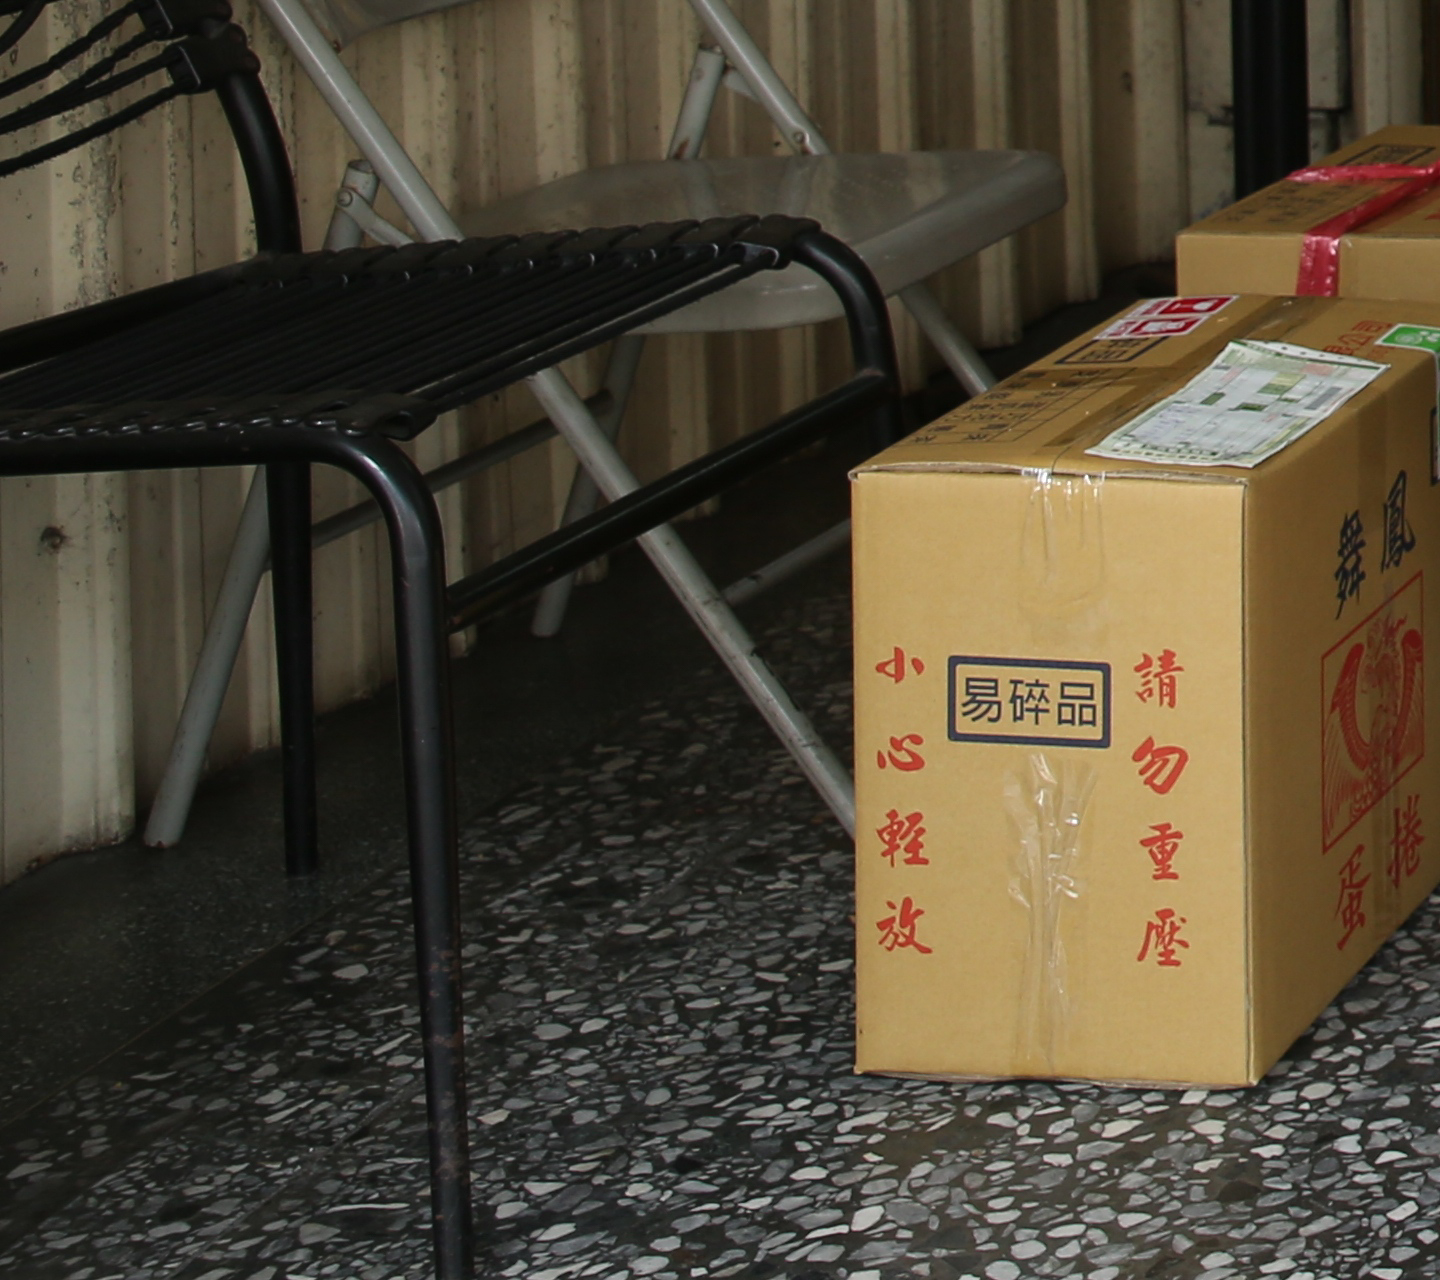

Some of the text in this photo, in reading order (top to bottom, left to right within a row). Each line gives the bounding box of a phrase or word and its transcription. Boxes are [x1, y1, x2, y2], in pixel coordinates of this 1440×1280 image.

[1335, 470, 1418, 620] 舞鳳
[959, 674, 1101, 729] 易碎品
[875, 646, 933, 956] 小心輕放
[1131, 648, 1191, 970] 請勿重壓
[1336, 793, 1427, 953] 蛋捲
